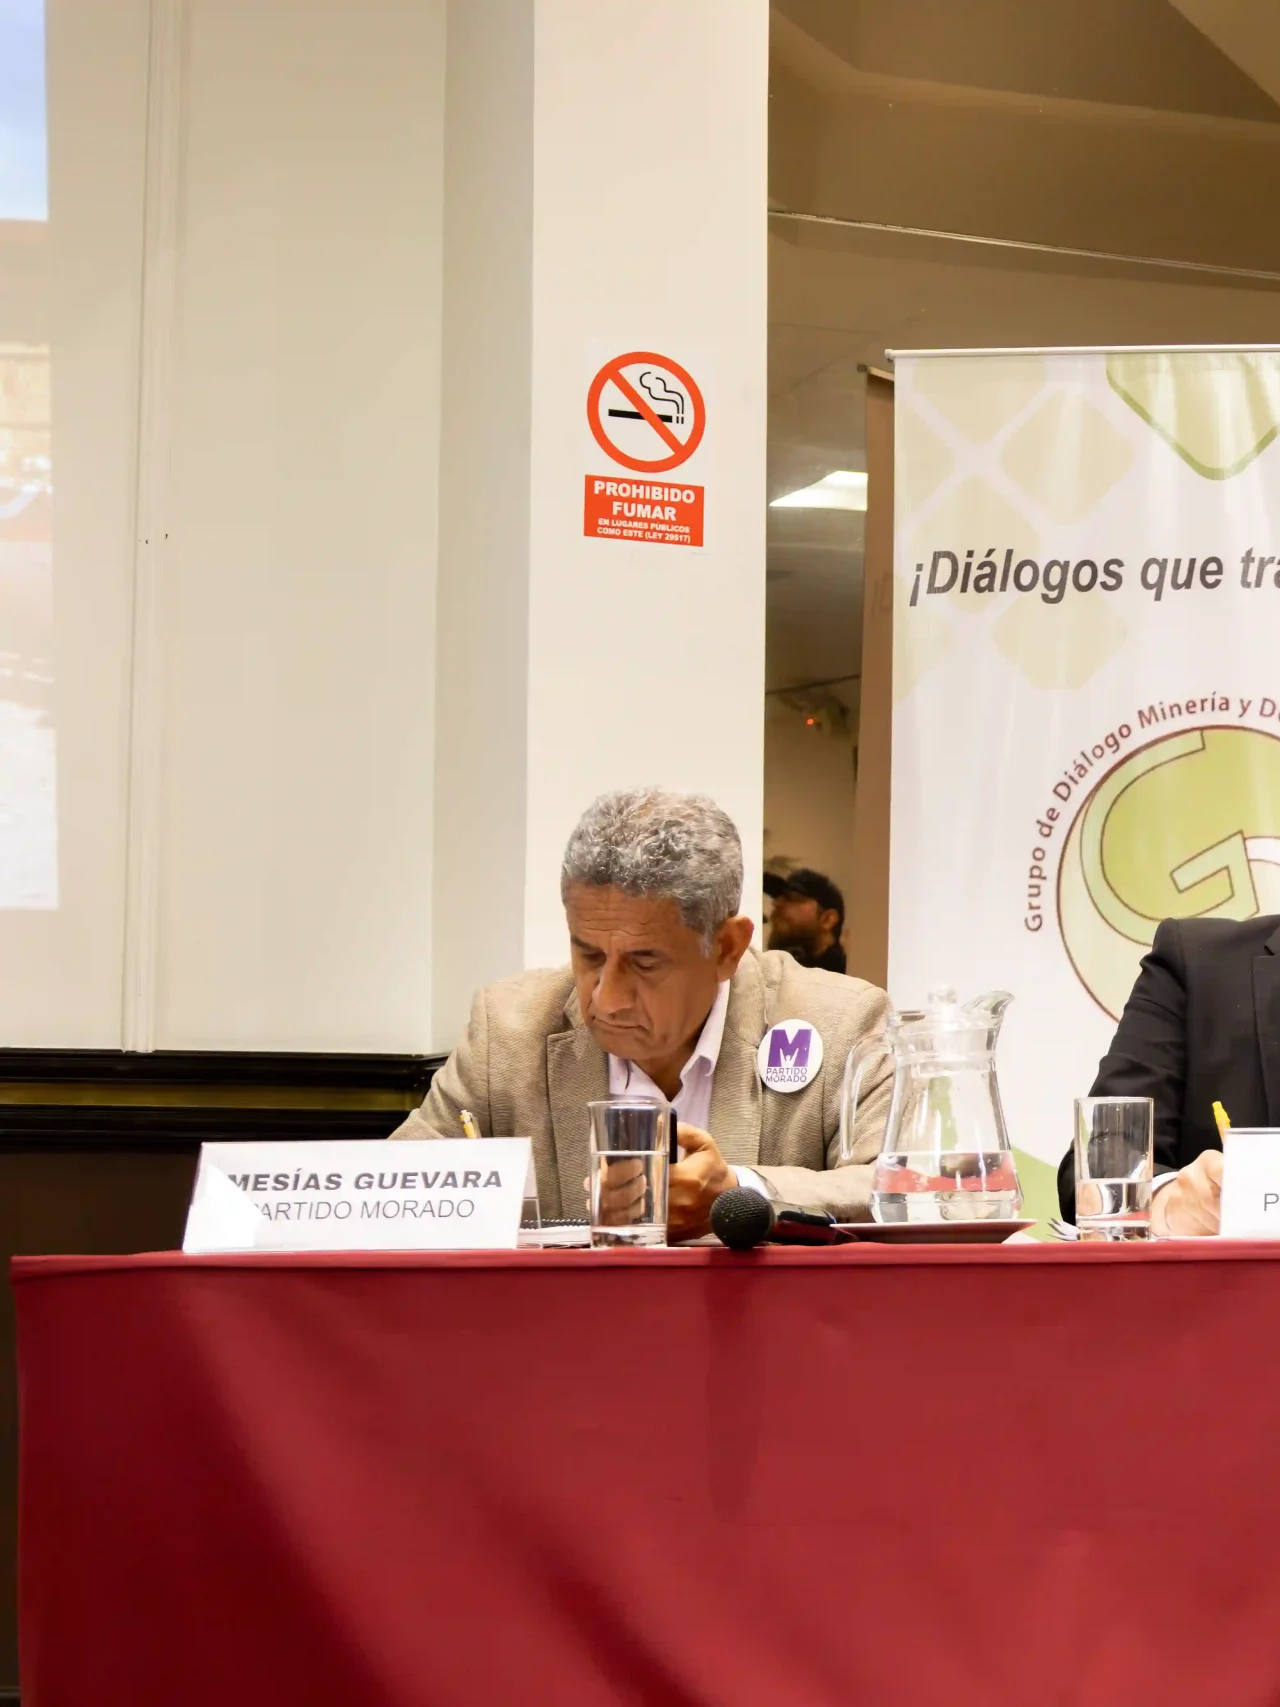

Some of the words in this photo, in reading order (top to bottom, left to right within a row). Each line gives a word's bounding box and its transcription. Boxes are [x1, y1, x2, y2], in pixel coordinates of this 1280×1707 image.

[594, 480, 695, 504] PROHIBIDO
[612, 501, 676, 521] FUMAR
[597, 527, 621, 535] COMO
[623, 529, 643, 537] ESTE
[645, 531, 663, 539] (LEY
[598, 518, 609, 526] EN
[611, 519, 648, 529] LUGARES
[910, 547, 1124, 607] ¡Diálogos
[1139, 554, 1224, 602] que
[1025, 846, 1047, 932] Grupo
[1038, 807, 1060, 839] de
[1052, 723, 1132, 803] Diálogo
[1137, 691, 1230, 729] Minería
[1239, 698, 1252, 717] y
[354, 1170, 502, 1190] GUEVARA
[253, 1200, 352, 1221] ARTIDO
[360, 1199, 475, 1220] MORADO
